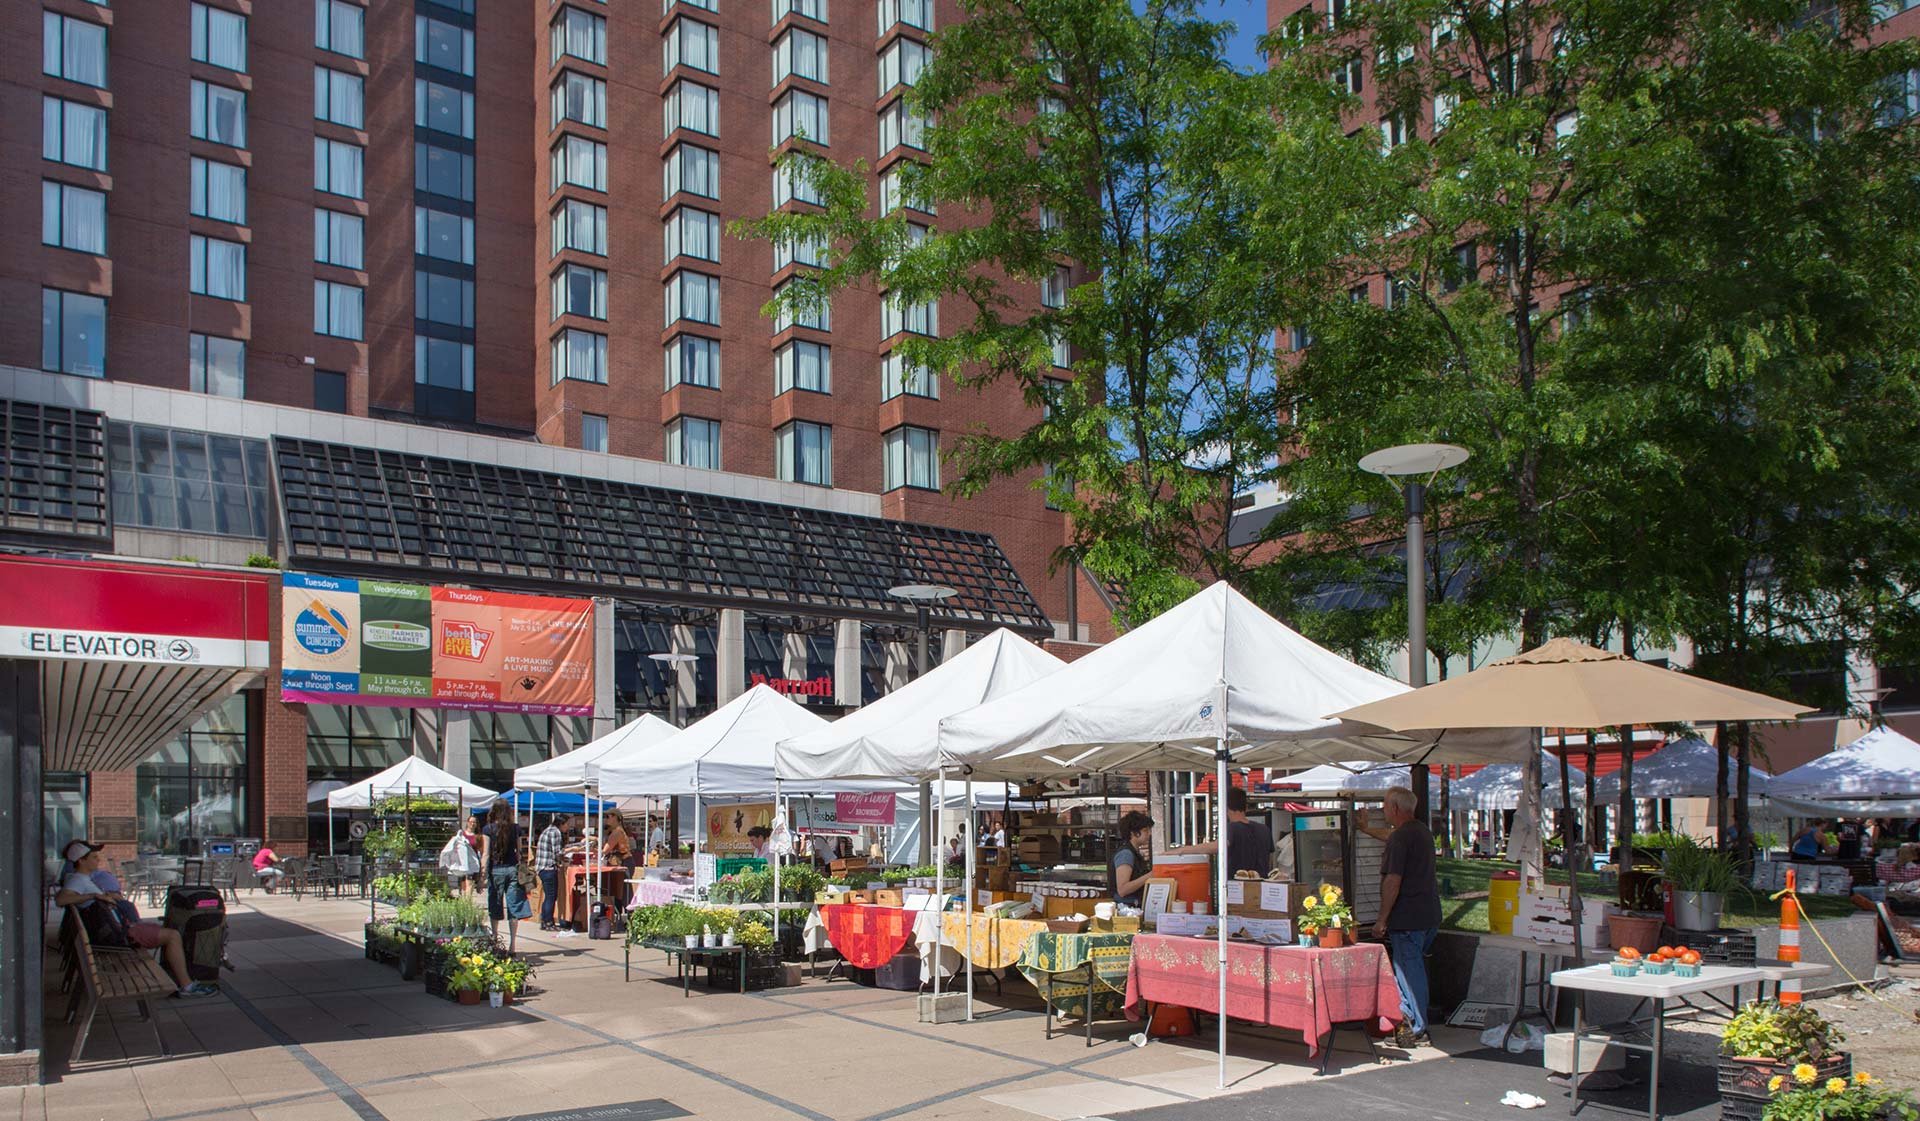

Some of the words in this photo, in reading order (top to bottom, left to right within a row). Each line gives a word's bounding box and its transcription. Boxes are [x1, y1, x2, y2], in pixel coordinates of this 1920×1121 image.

[304, 578, 339, 589] Tuesdays
[373, 585, 417, 596] Wednesdays
[449, 591, 483, 602] Thursdays
[296, 624, 331, 634] summer
[392, 630, 424, 638] FARMERS
[31, 632, 156, 658] ELEVATOR
[306, 636, 341, 647] CONCERTS
[446, 644, 472, 656] FIVE
[504, 656, 554, 665] ART-MAKING
[311, 672, 331, 681] Noon
[374, 676, 383, 685] 11
[285, 680, 304, 688] June
[305, 680, 334, 691] through
[336, 682, 356, 691] Sept.
[368, 684, 381, 694] May
[384, 684, 411, 695] through
[413, 686, 428, 695] Oct.
[437, 689, 453, 697] June
[454, 690, 479, 699] through
[481, 690, 496, 699] Aug.
